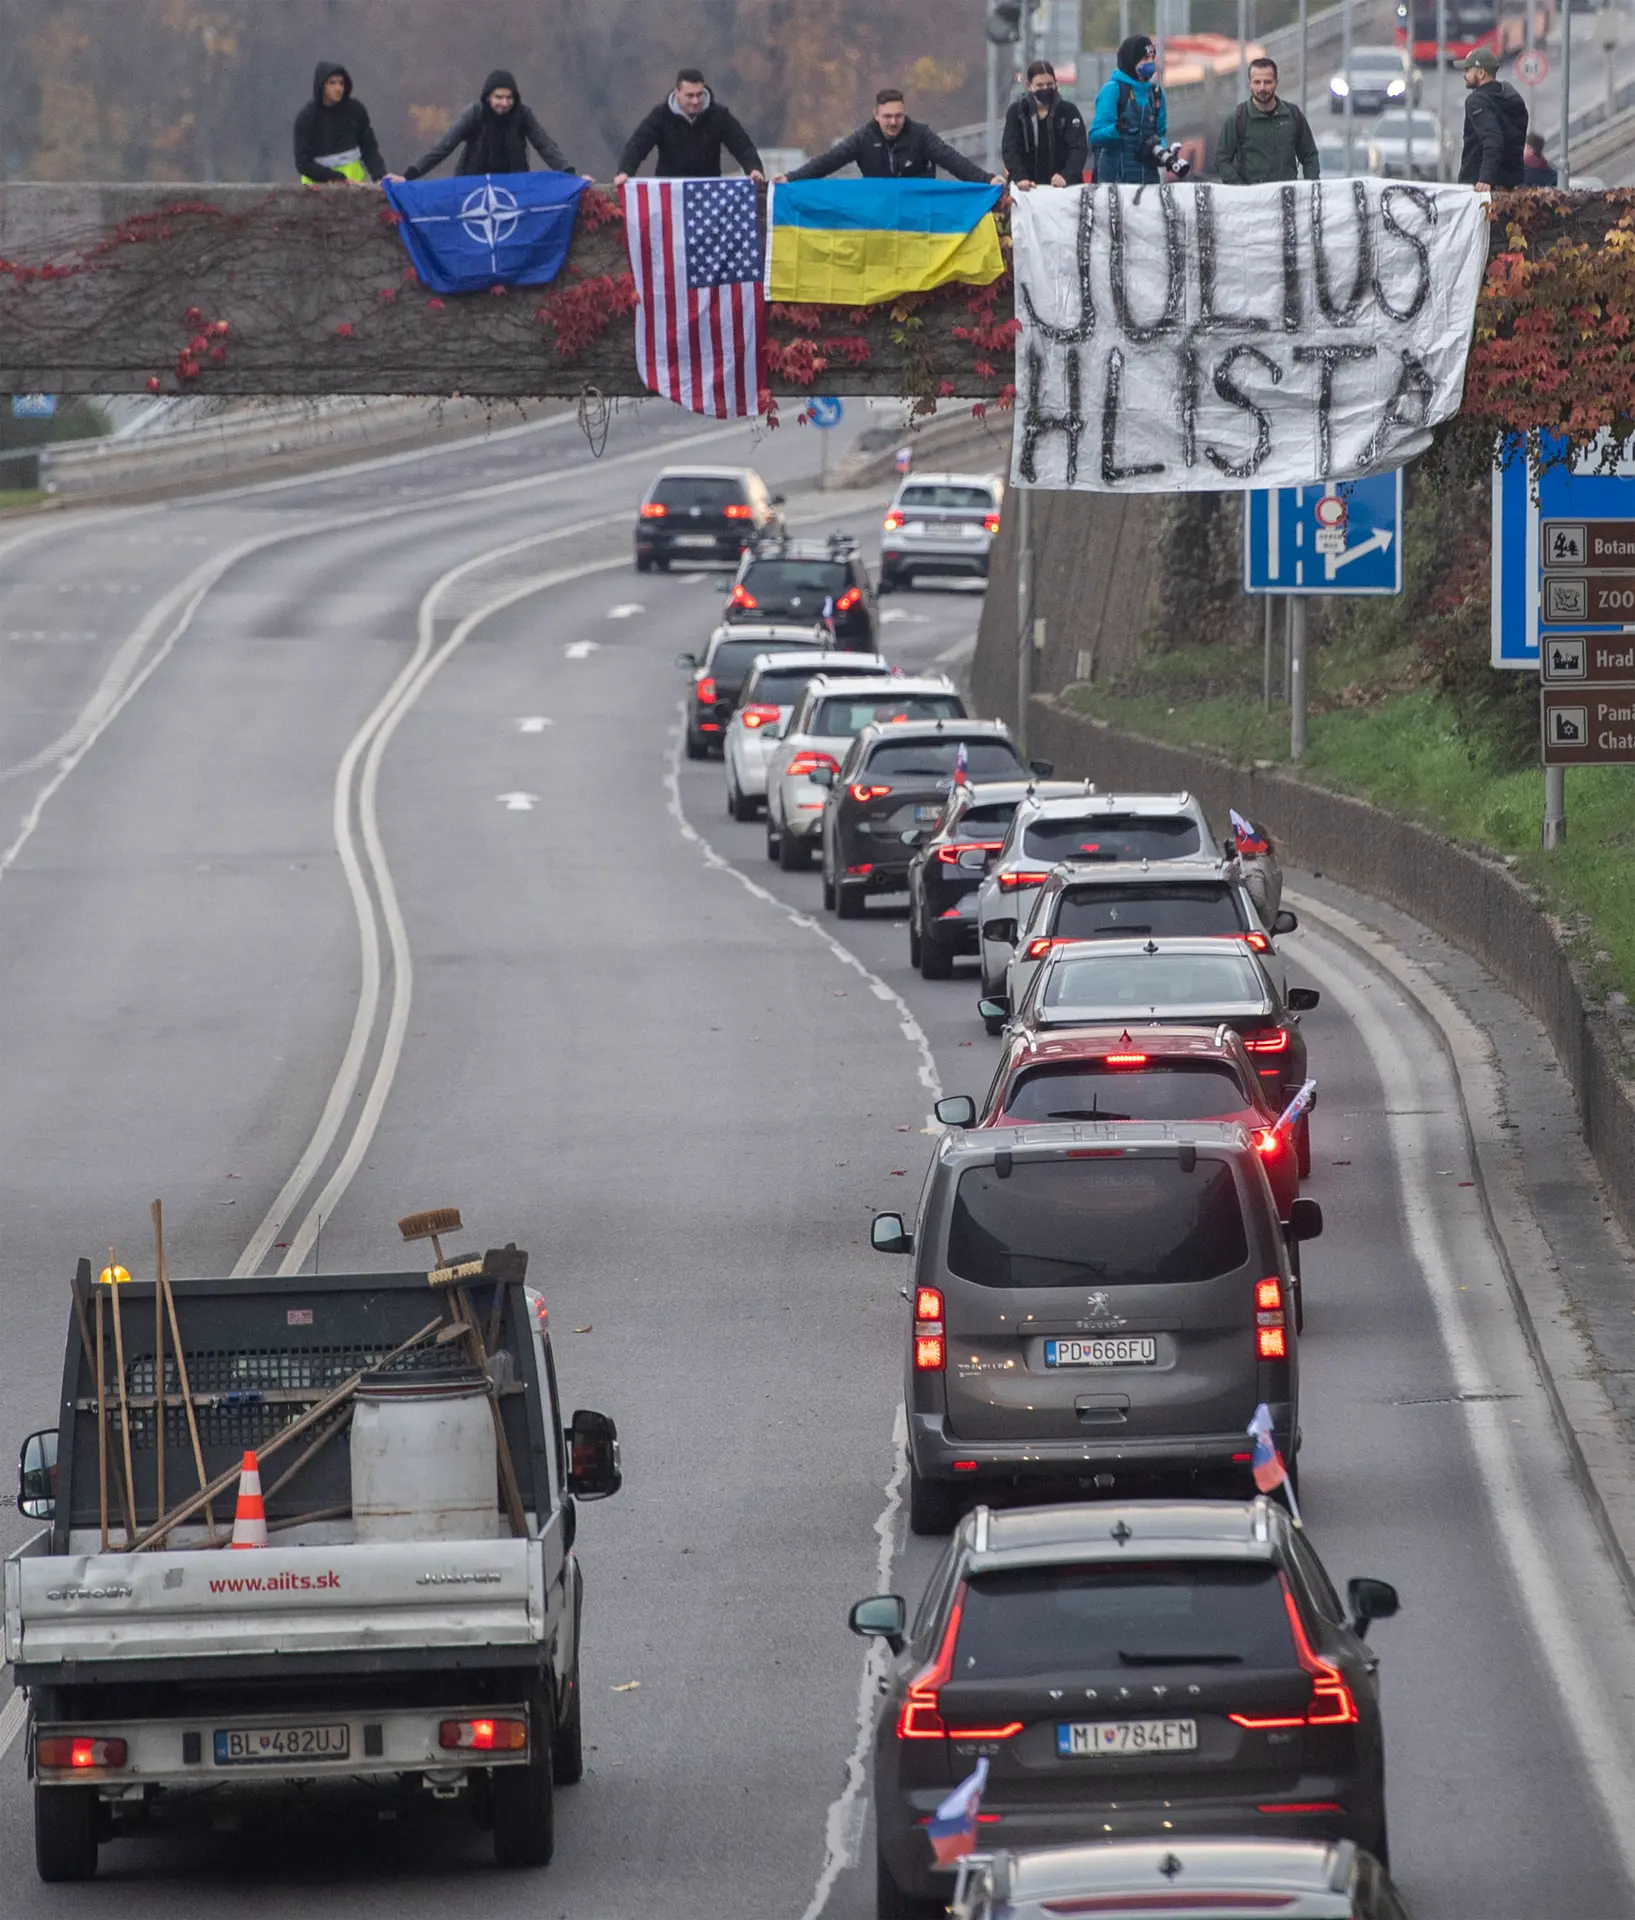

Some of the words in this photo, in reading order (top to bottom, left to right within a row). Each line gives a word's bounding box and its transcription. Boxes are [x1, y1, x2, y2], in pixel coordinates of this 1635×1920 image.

[1019, 338, 1435, 486] HLISTA
[1594, 537, 1635, 555] Botan
[1598, 589, 1635, 609] ZOO
[1596, 647, 1634, 668] Hrad
[1058, 1342, 1082, 1361] PD
[1092, 1340, 1152, 1360] 666FU
[208, 1570, 342, 1594] www.aiits.sk
[271, 1728, 345, 1754] 482UJ
[1116, 1722, 1194, 1749] 784FM
